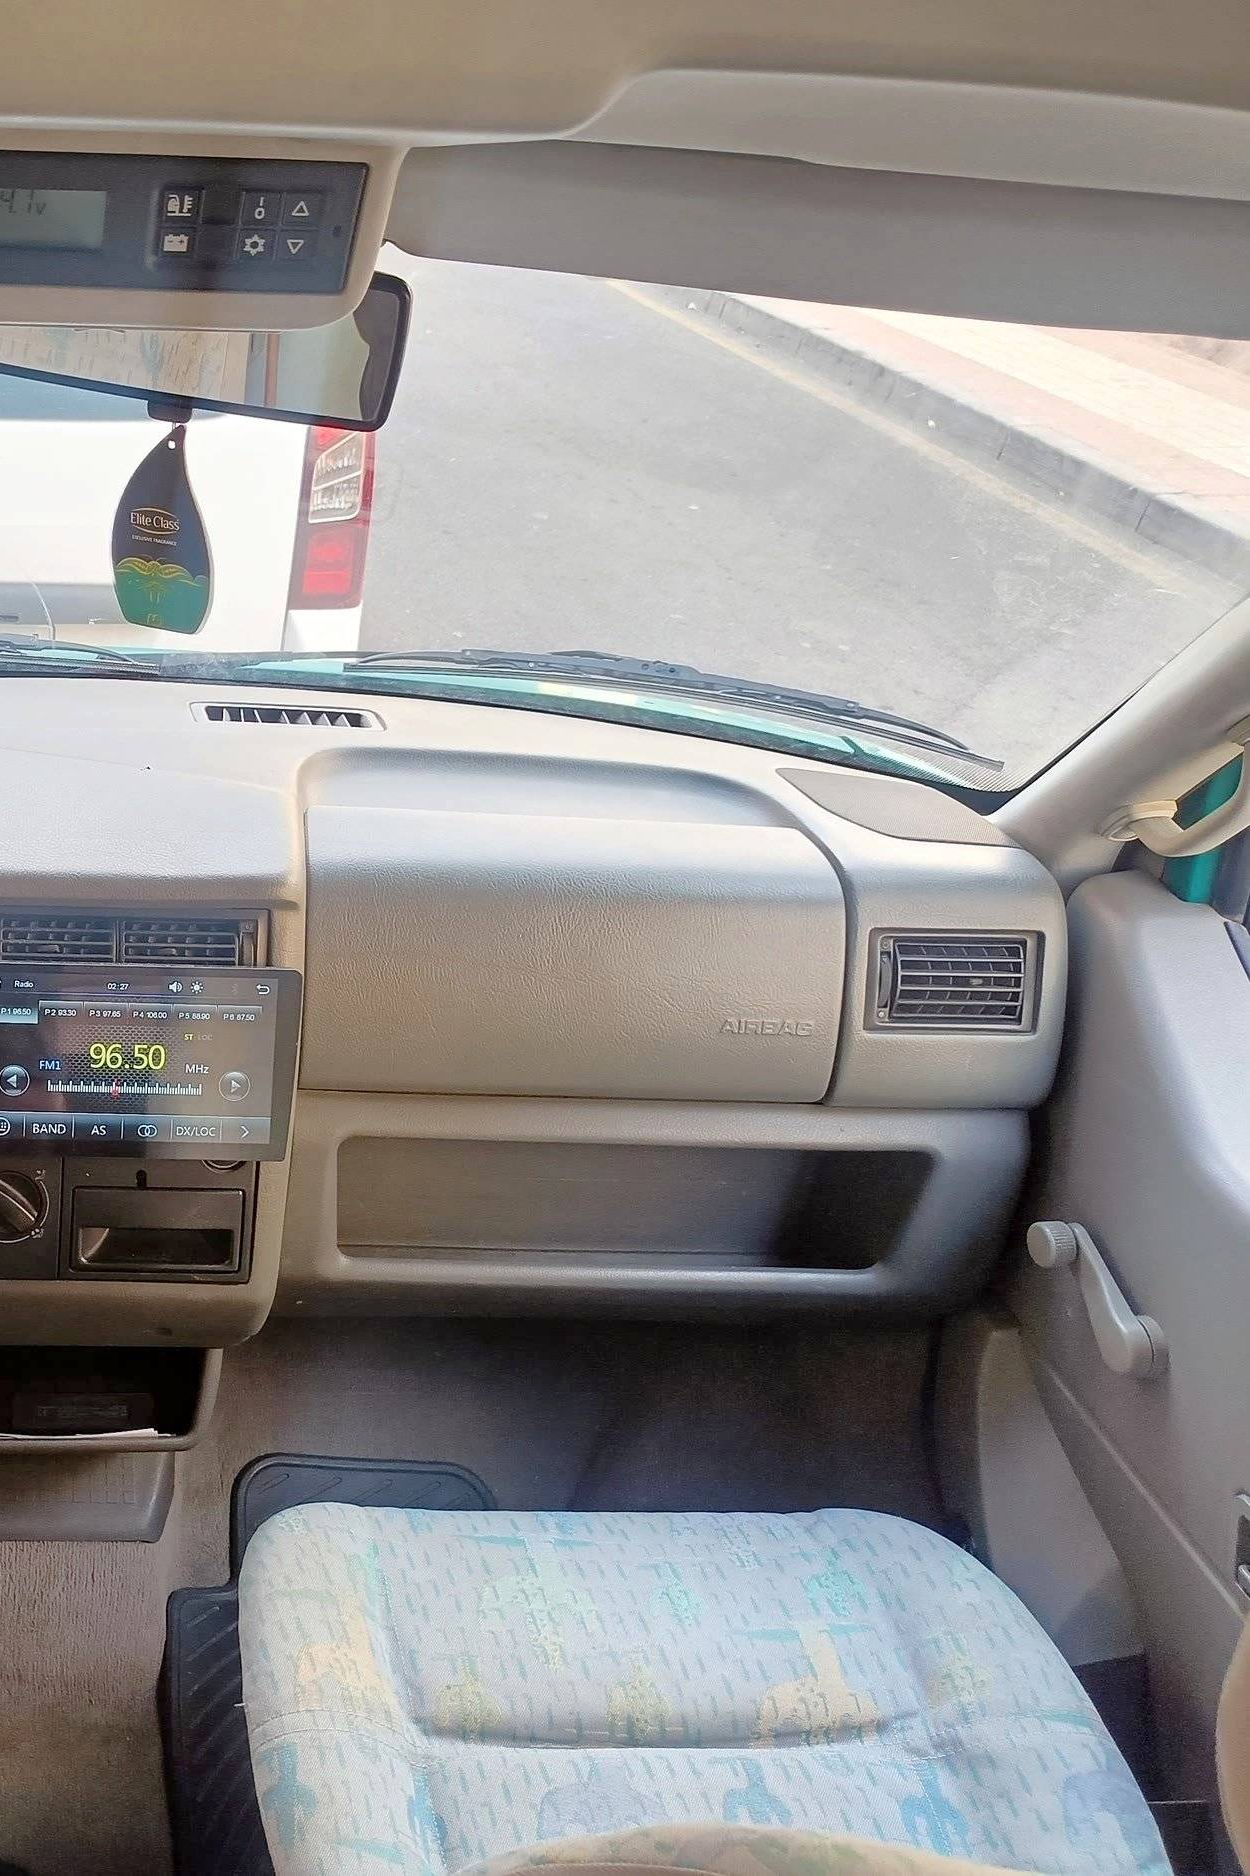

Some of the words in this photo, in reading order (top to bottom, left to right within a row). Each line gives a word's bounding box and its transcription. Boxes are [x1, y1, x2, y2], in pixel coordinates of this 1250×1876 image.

[130, 512, 151, 526] Elite
[153, 516, 180, 531] Class
[14, 980, 35, 989] Radio
[107, 983, 130, 991] 02:27
[720, 1018, 813, 1037] AIRBAG
[88, 1042, 167, 1071] 96.50
[38, 1060, 62, 1071] FM1
[184, 1064, 210, 1075] MHz
[32, 1123, 67, 1135] BAND
[90, 1125, 107, 1136] AS
[176, 1126, 216, 1138] DX/LOC
